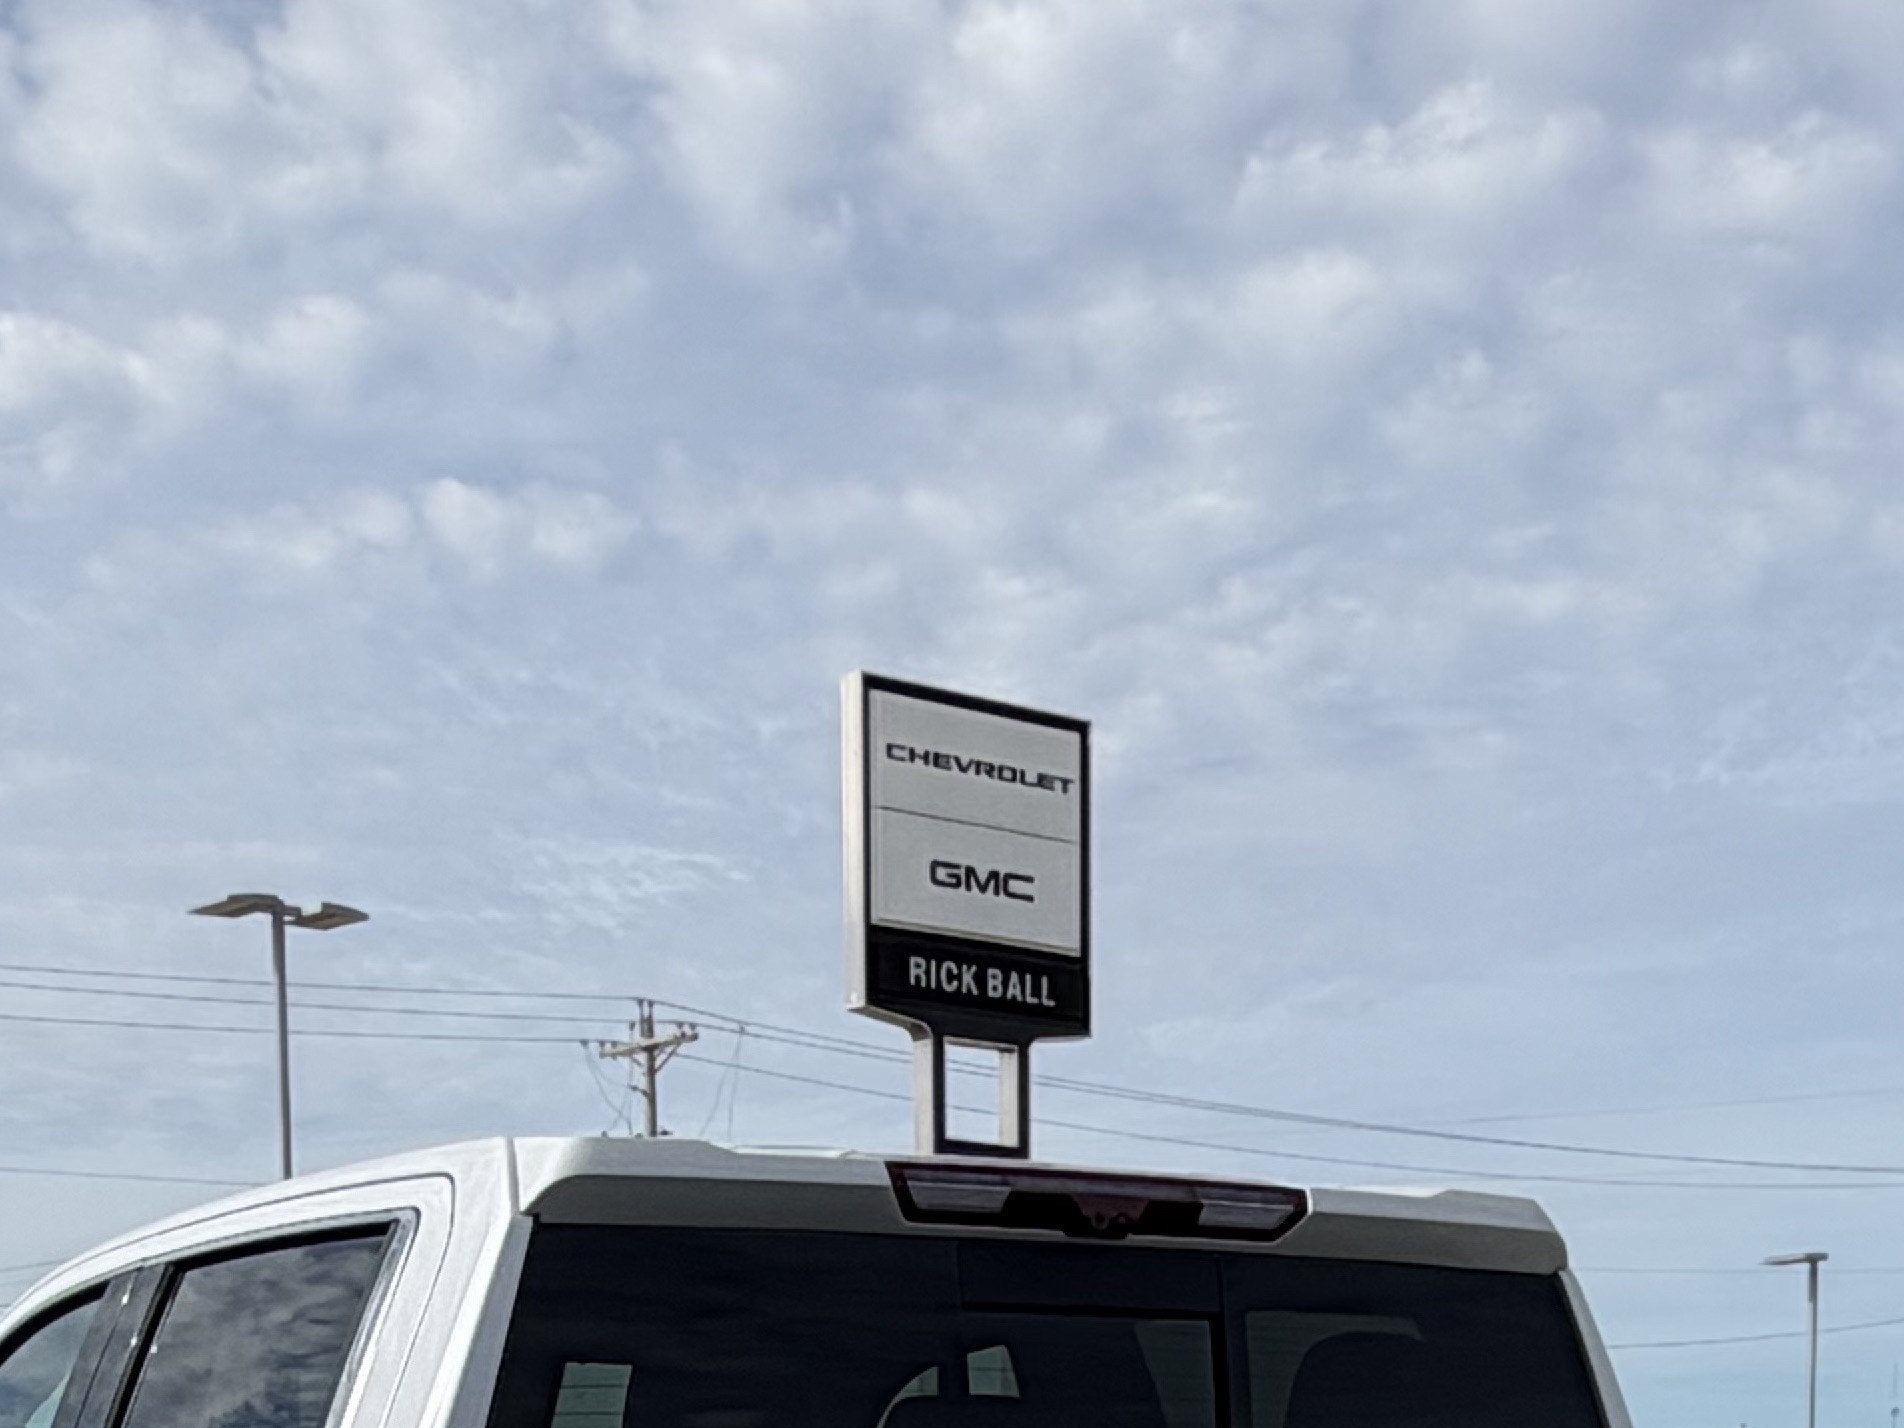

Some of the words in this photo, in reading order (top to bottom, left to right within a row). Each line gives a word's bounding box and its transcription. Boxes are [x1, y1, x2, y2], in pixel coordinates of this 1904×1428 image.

[886, 742, 1074, 796] CHEVROLET
[928, 859, 1035, 903] GMC
[908, 955, 979, 996] RICK
[987, 967, 1057, 1007] BALL
